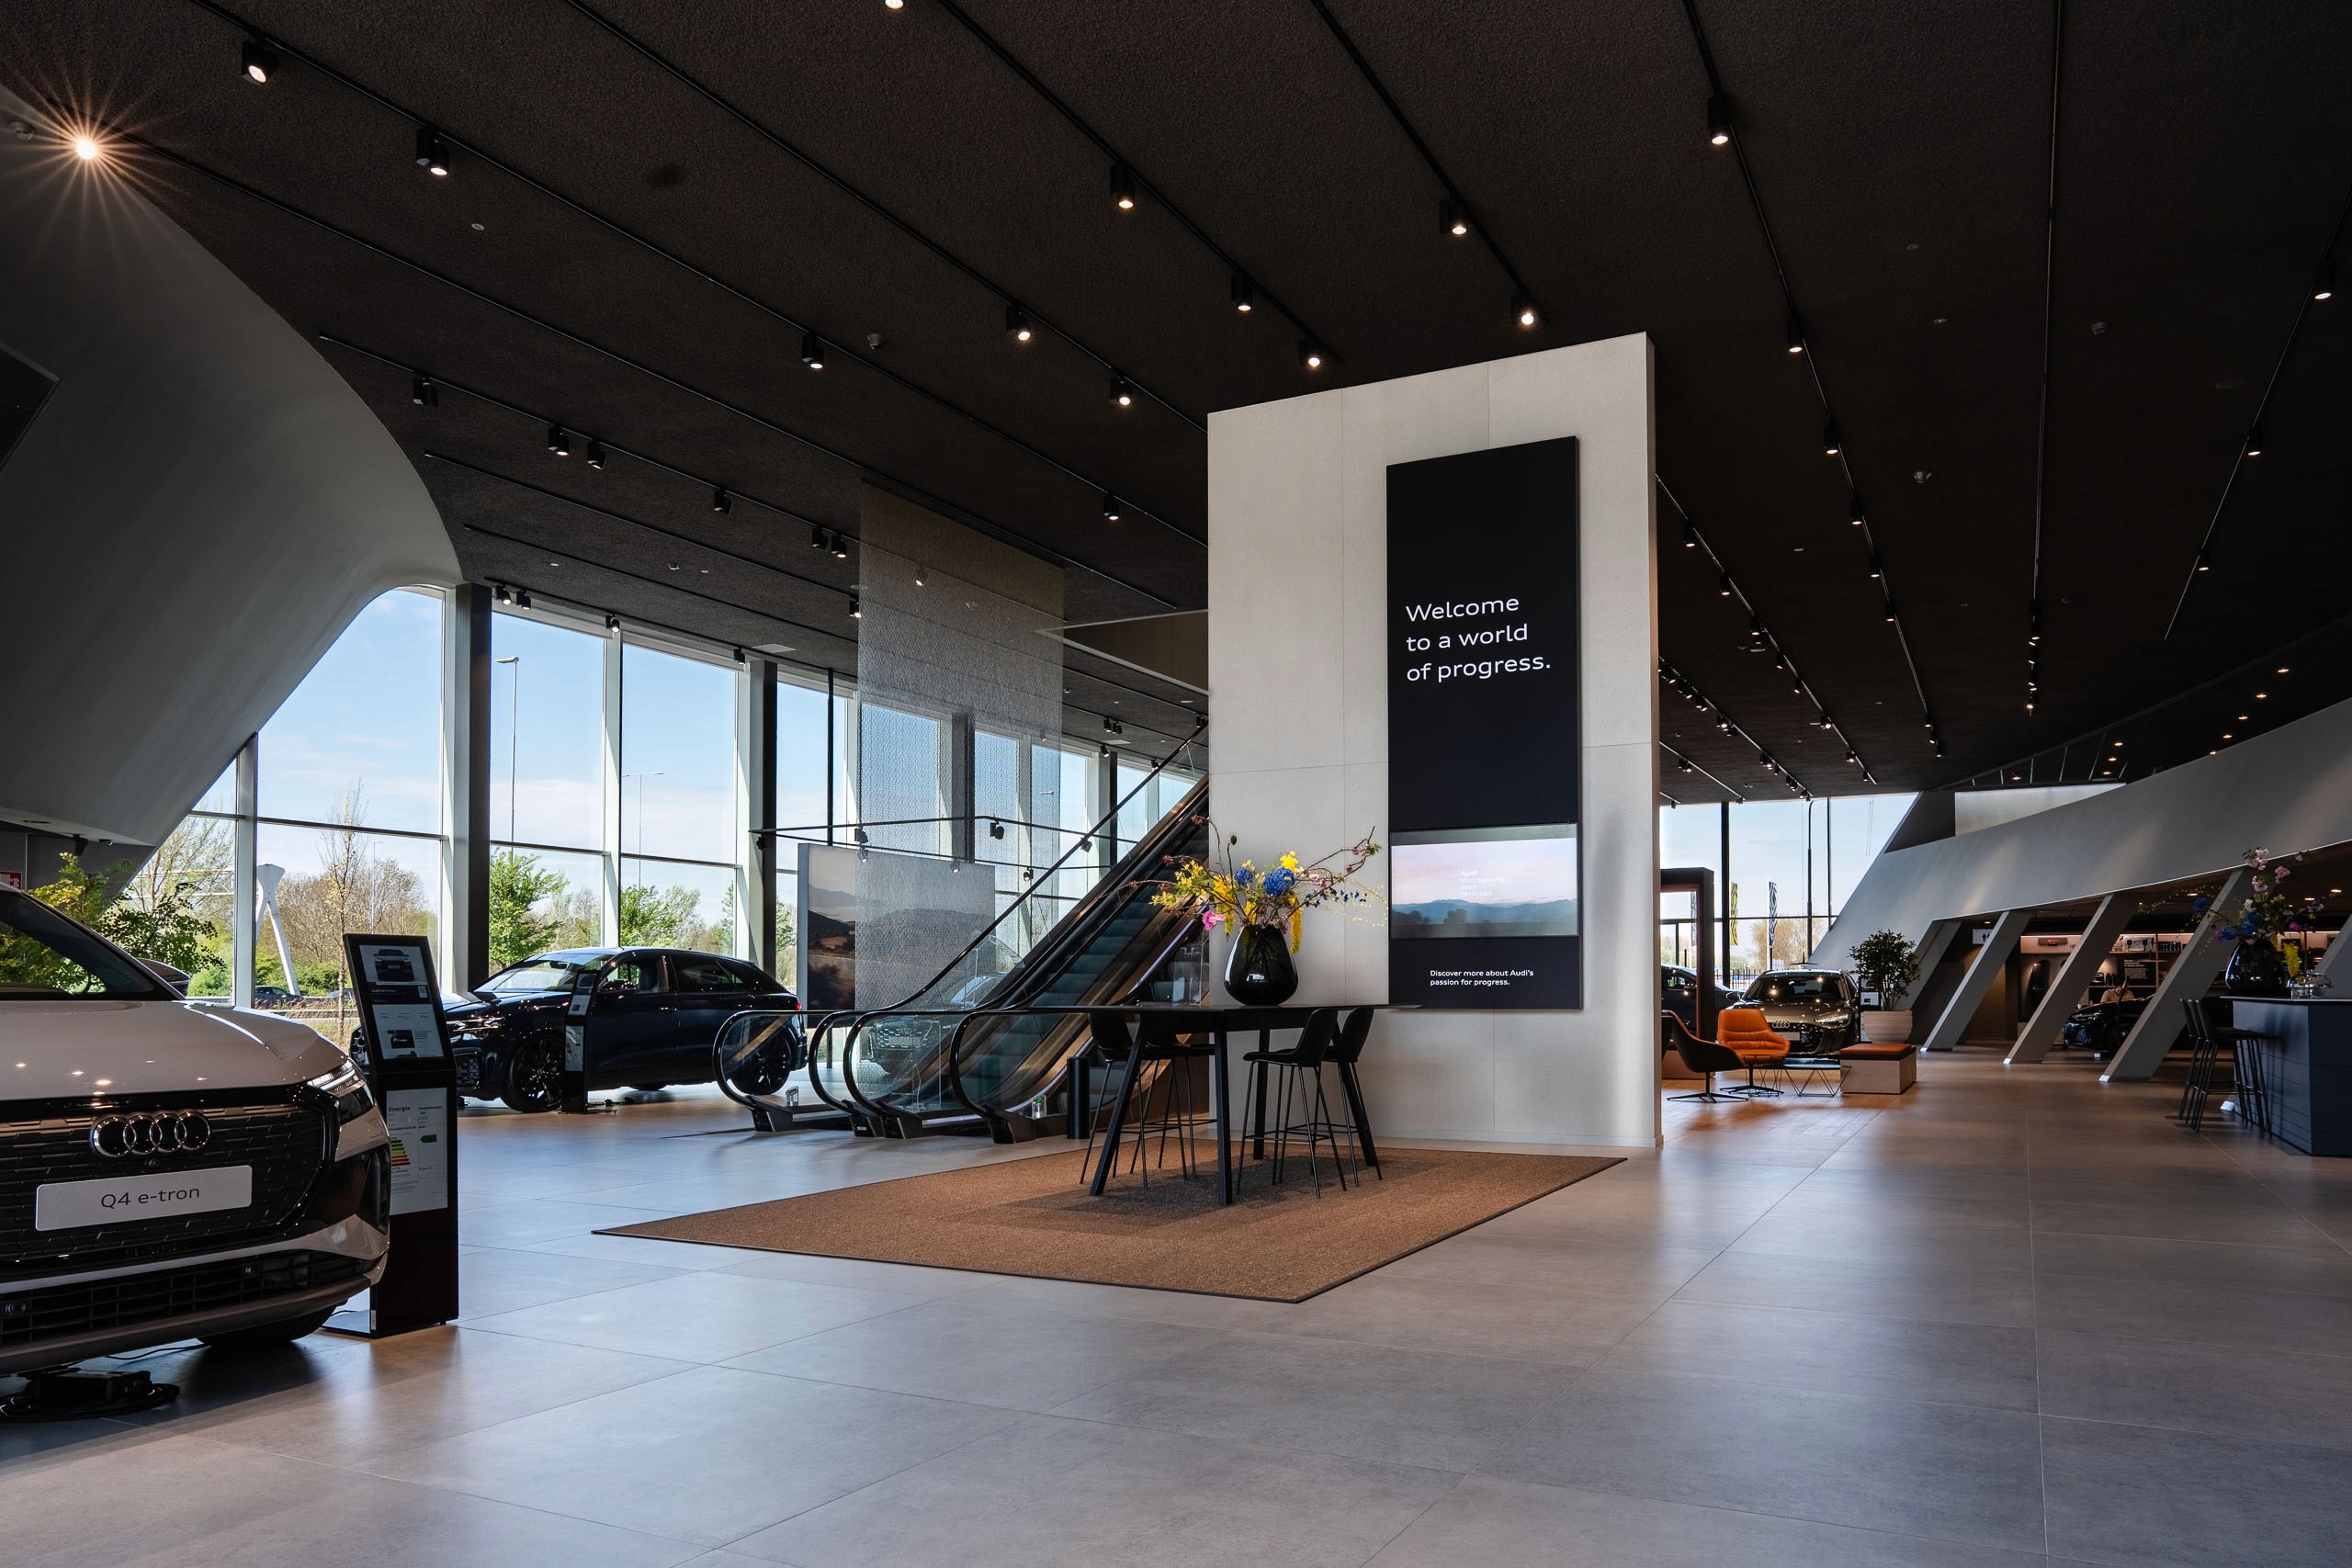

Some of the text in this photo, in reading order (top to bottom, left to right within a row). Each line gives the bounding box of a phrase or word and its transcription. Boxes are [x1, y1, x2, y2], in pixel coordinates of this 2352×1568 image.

[1405, 597, 1520, 622] Welcome
[1406, 623, 1528, 652] to a world
[1407, 656, 1551, 683] of progress.
[101, 1188, 200, 1209] Q4 e-tron
